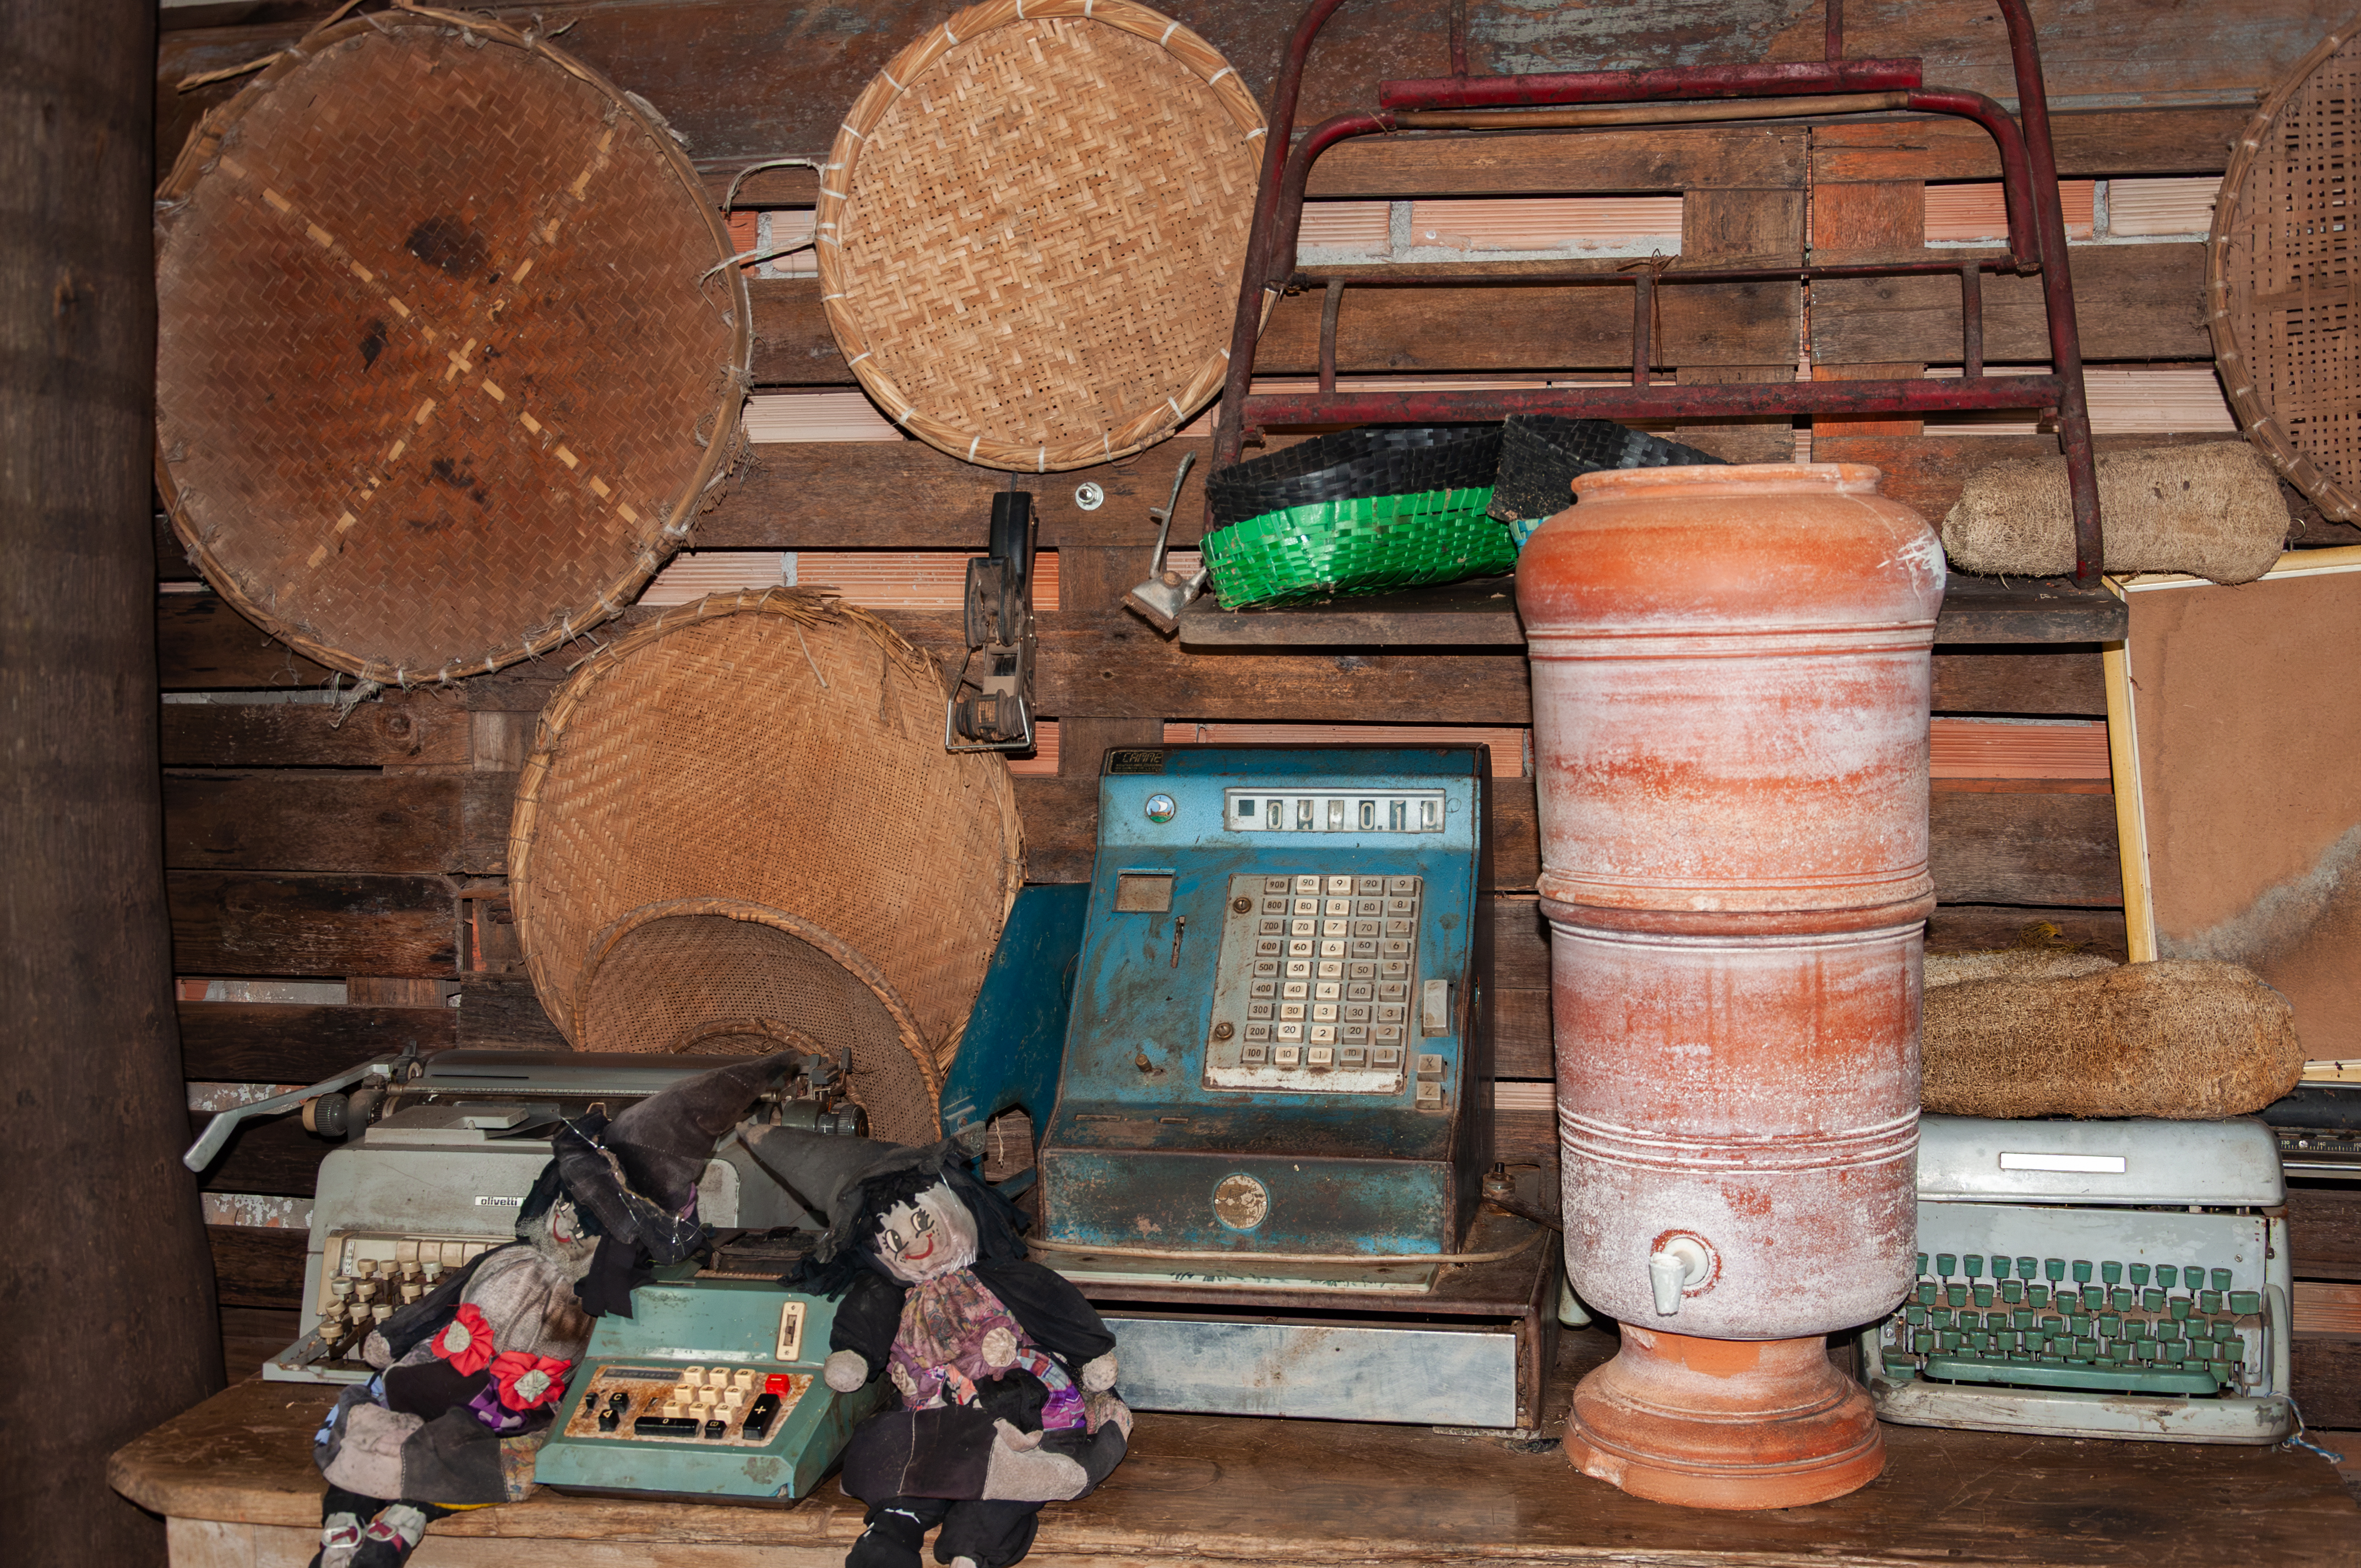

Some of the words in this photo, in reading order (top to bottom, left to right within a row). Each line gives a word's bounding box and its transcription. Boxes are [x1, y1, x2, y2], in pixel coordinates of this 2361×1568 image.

[1426, 1058, 1433, 1068] X
[1425, 1086, 1433, 1096] Z
[481, 1196, 518, 1206] olivetti
